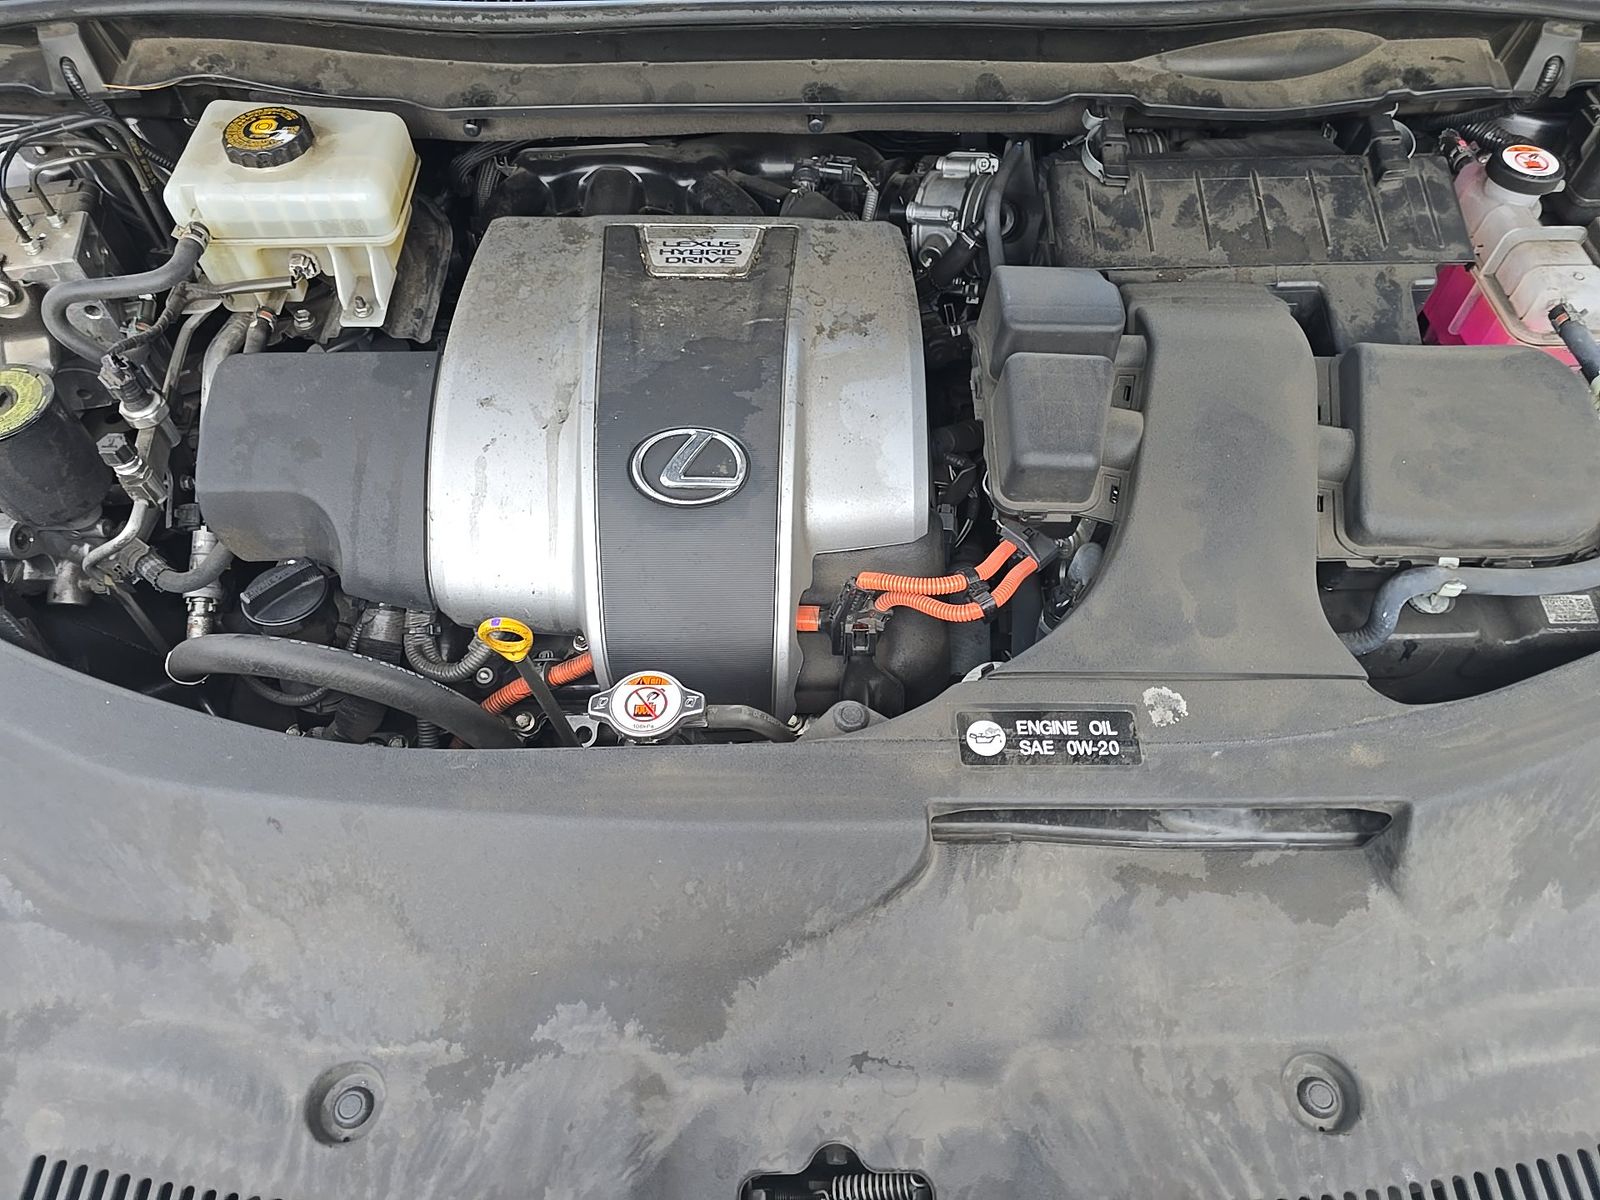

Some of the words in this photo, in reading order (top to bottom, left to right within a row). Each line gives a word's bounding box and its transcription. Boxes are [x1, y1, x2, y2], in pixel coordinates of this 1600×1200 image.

[662, 240, 741, 248] LEXUS
[659, 248, 743, 256] HYBRID
[664, 256, 737, 264] DRIVE
[1015, 719, 1079, 736] ENGINE
[1088, 720, 1118, 736] OIL
[1019, 739, 1056, 756] SAE
[1066, 740, 1120, 756] 0W-20
